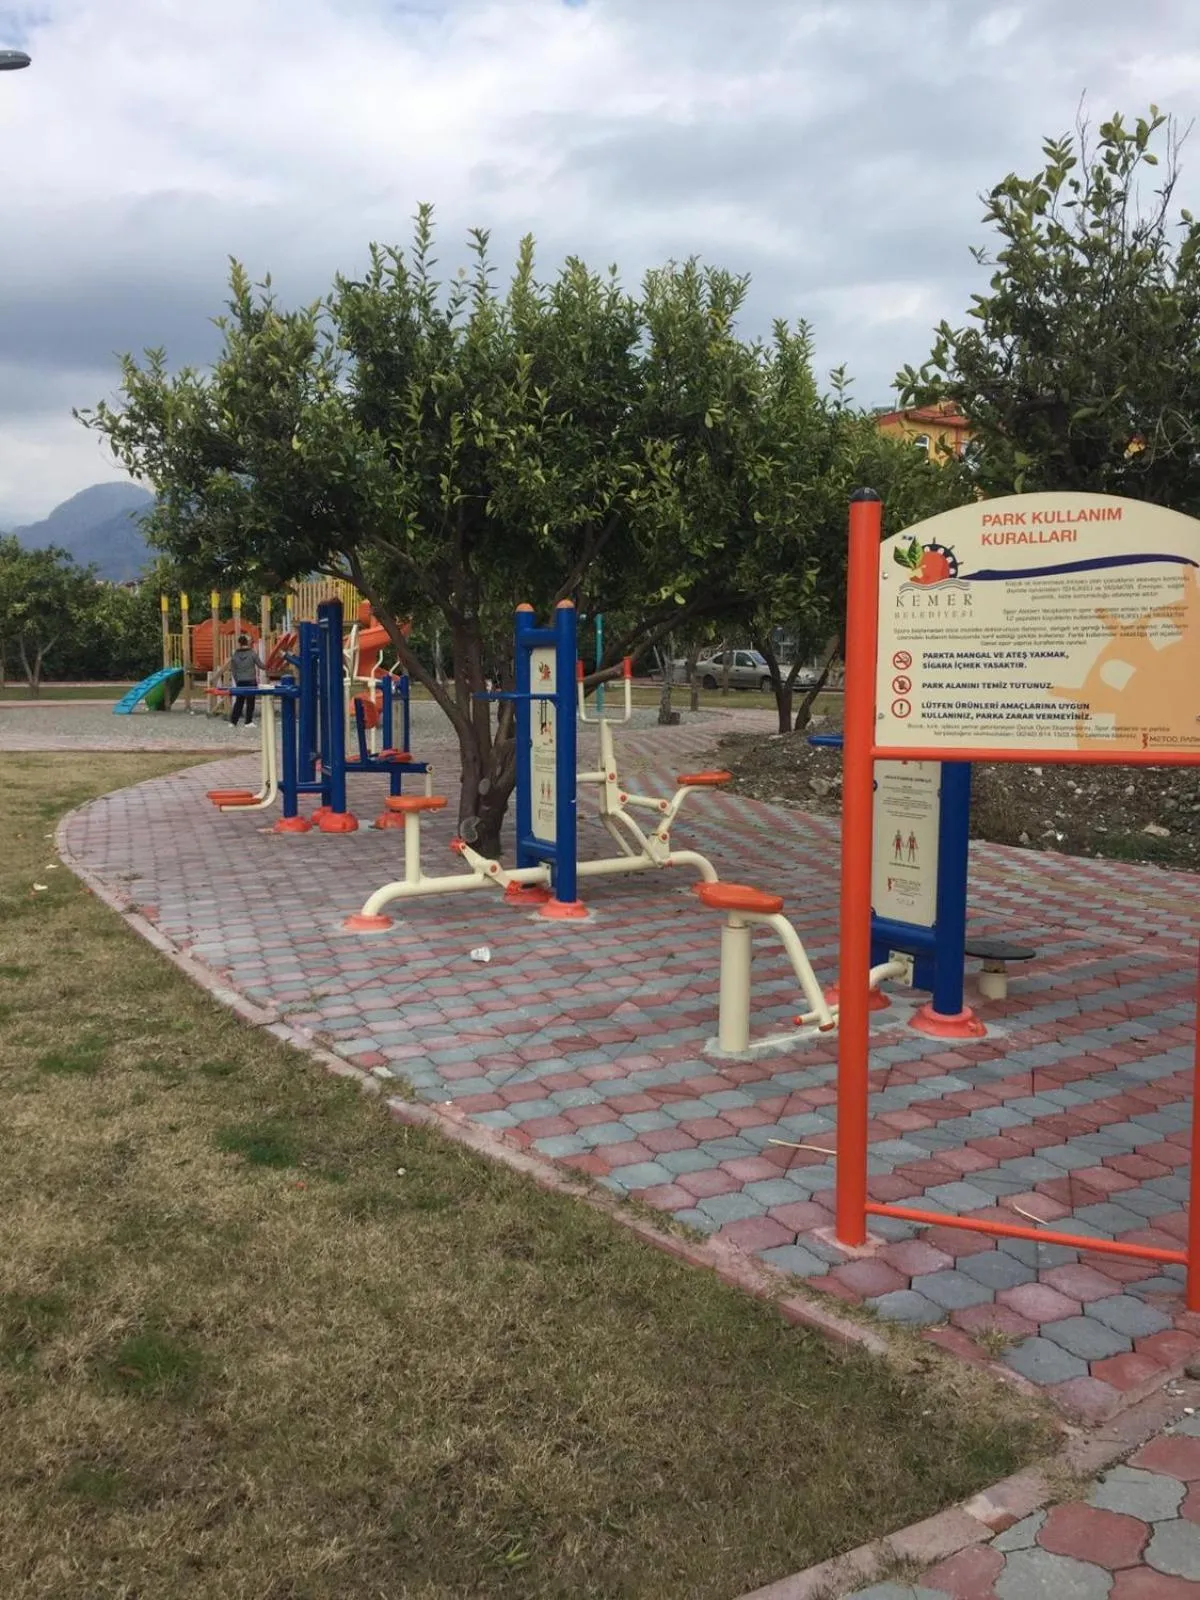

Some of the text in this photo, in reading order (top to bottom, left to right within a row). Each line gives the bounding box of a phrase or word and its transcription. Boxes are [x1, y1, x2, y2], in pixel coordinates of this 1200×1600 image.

[982, 507, 1123, 527] PARK KULLANIM
[981, 529, 1078, 546] KURALLARI
[896, 594, 973, 607] KEMER
[921, 682, 944, 690] PARK
[945, 682, 980, 690] ALANINI
[921, 701, 954, 710] LÜTFEN
[1058, 702, 1090, 711] UYGUN
